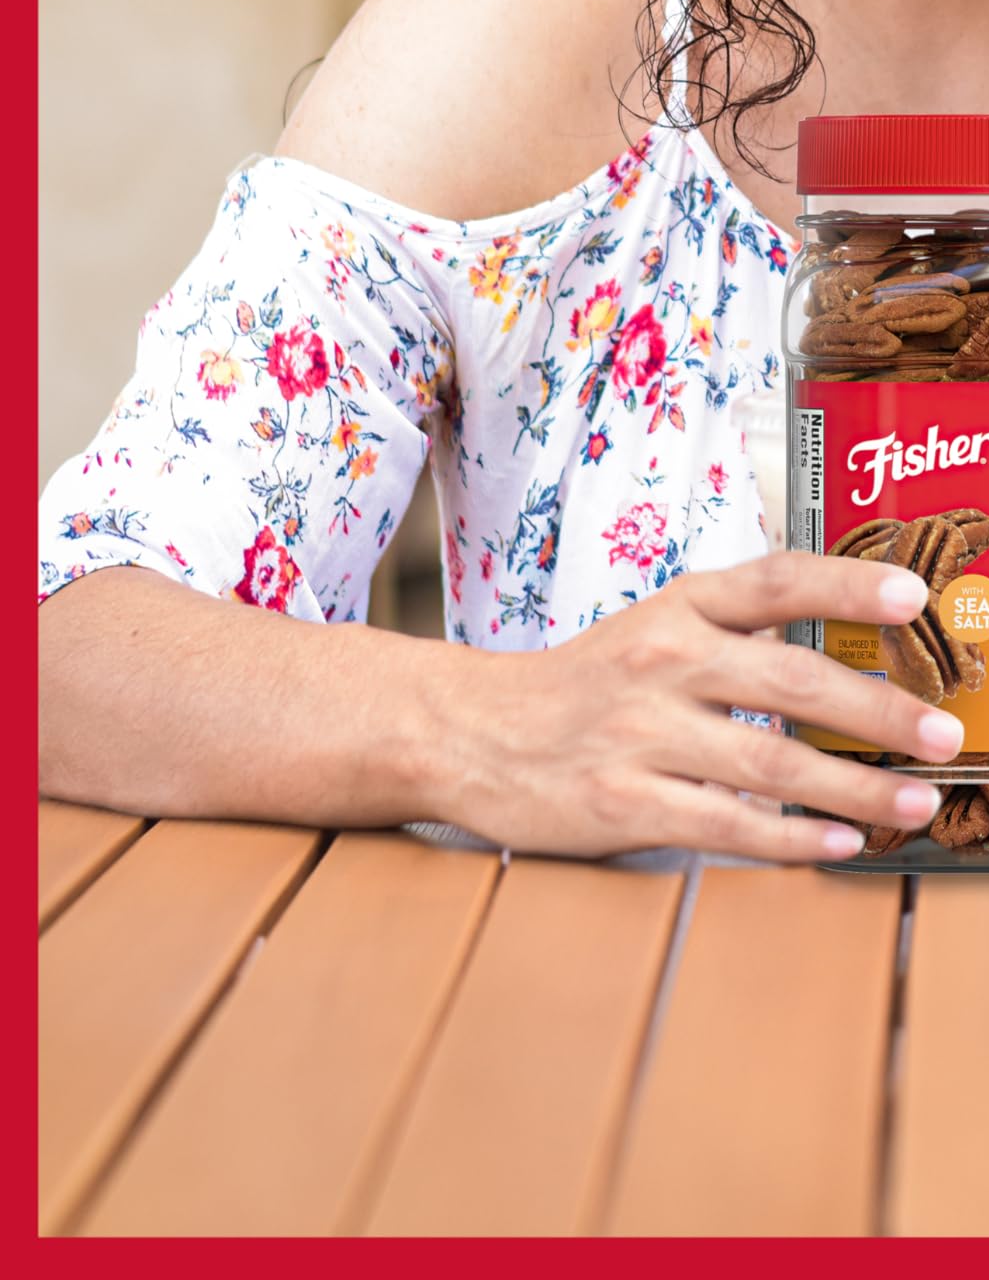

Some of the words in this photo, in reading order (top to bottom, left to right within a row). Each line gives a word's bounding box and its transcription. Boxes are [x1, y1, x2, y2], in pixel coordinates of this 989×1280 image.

[801, 414, 809, 468] Facts
[812, 414, 823, 500] Nutrition
[961, 587, 984, 595] WITH
[838, 639, 869, 649] ENLARGED
[870, 639, 880, 649] TO
[838, 649, 855, 659] SHOW
[856, 650, 878, 660] DETAIL
